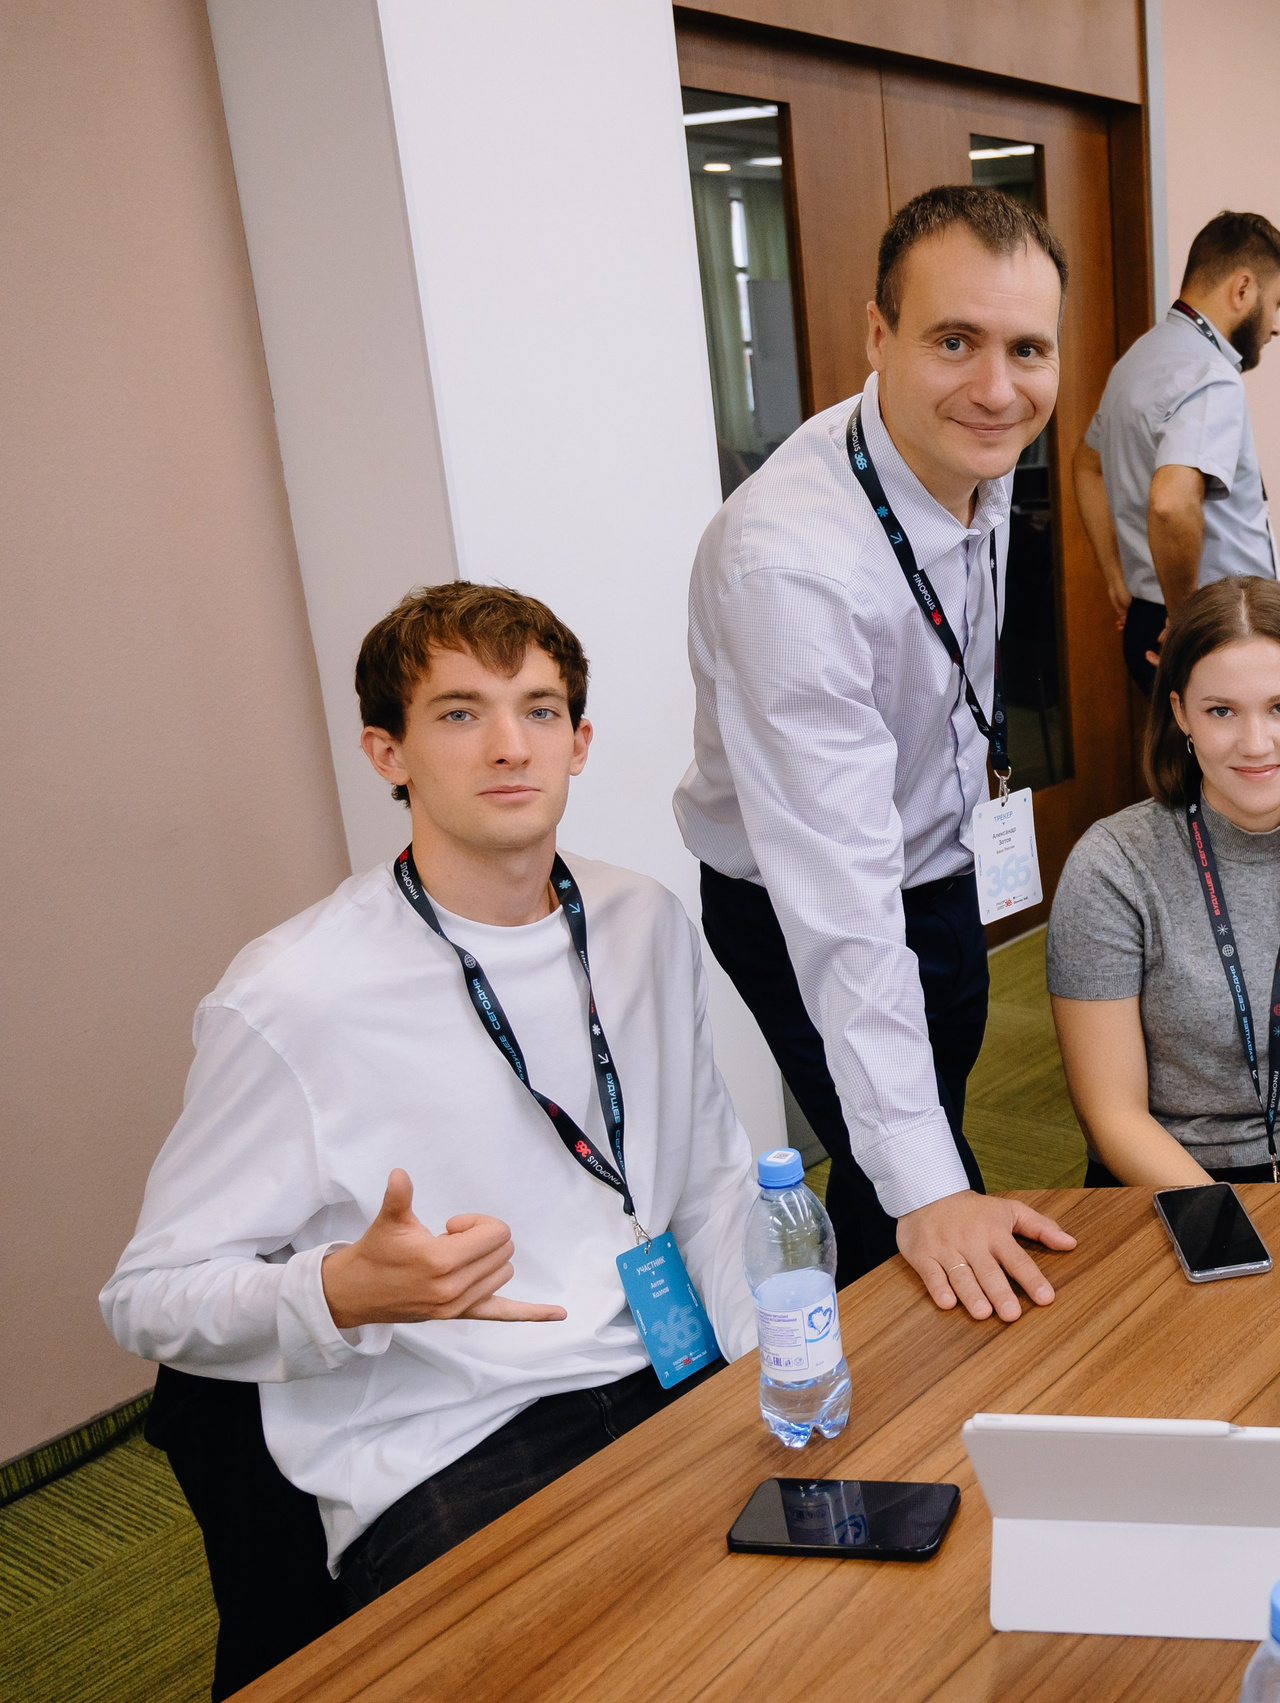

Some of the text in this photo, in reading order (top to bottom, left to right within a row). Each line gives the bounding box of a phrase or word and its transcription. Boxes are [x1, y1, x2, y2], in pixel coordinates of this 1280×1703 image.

[854, 452, 868, 470] 365
[913, 573, 942, 626] FINOPOLIS 365
[992, 827, 1017, 839] Александр
[994, 811, 1013, 822] ТРЕКЕР
[400, 862, 420, 900] FINOPOLIS
[986, 853, 1031, 898] 365
[1192, 822, 1220, 916] БУДУЩЕЕ СЕГОДНЯ
[473, 979, 525, 1081] БУДУЩЕЕ СЕГОДНЯ
[1230, 965, 1254, 1062] БУДУЩЕЕ СЕГОДНЯ
[606, 1073, 621, 1123] БУДУЩЕЕ
[1271, 1070, 1279, 1108] FINOPOLIS
[574, 1140, 621, 1185] FINOPOLIS 365
[636, 1256, 666, 1275] УЧАСТНИК
[651, 1305, 702, 1357] 365
